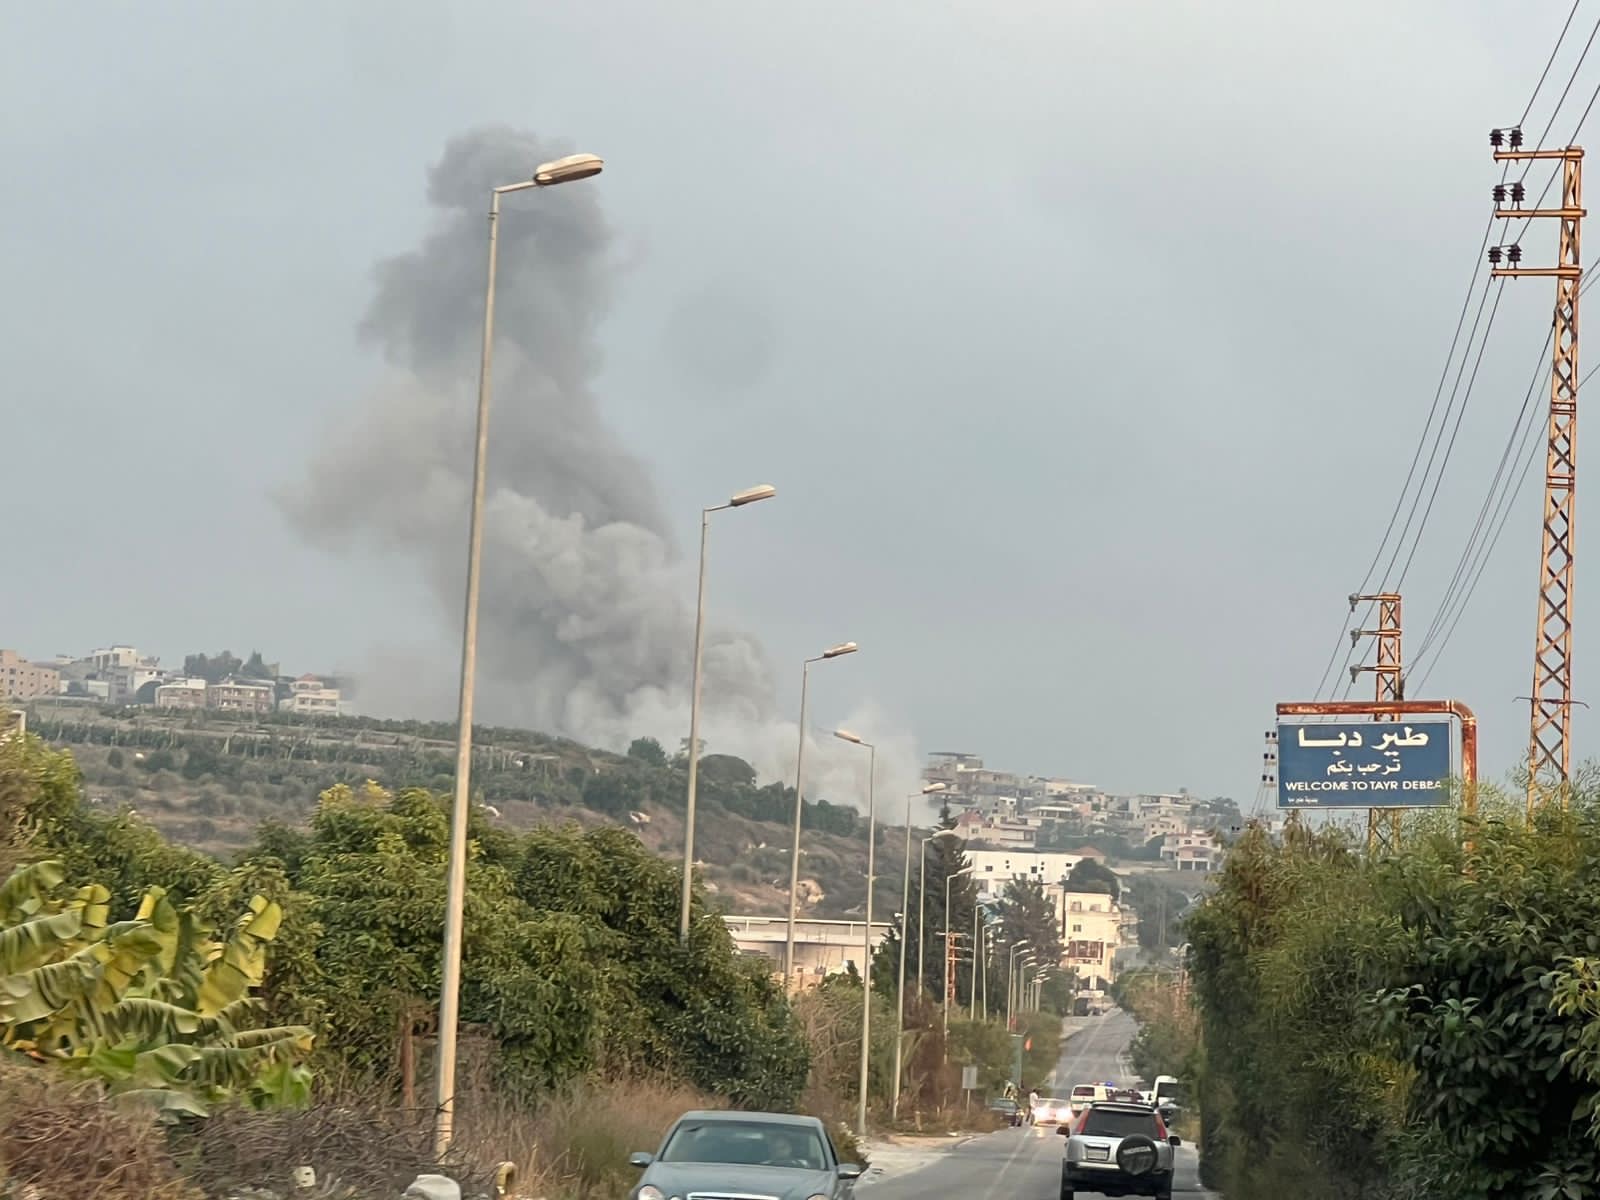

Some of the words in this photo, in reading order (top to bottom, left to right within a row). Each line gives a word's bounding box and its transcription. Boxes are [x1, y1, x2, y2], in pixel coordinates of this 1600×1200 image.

[1298, 727, 1362, 756] دبا
[1370, 726, 1429, 756] طير
[1326, 760, 1353, 776] بكم
[1357, 759, 1401, 775] ترحب
[1285, 781, 1349, 791] WELCOME
[1351, 781, 1368, 790] TO
[1369, 780, 1398, 790] TAYR
